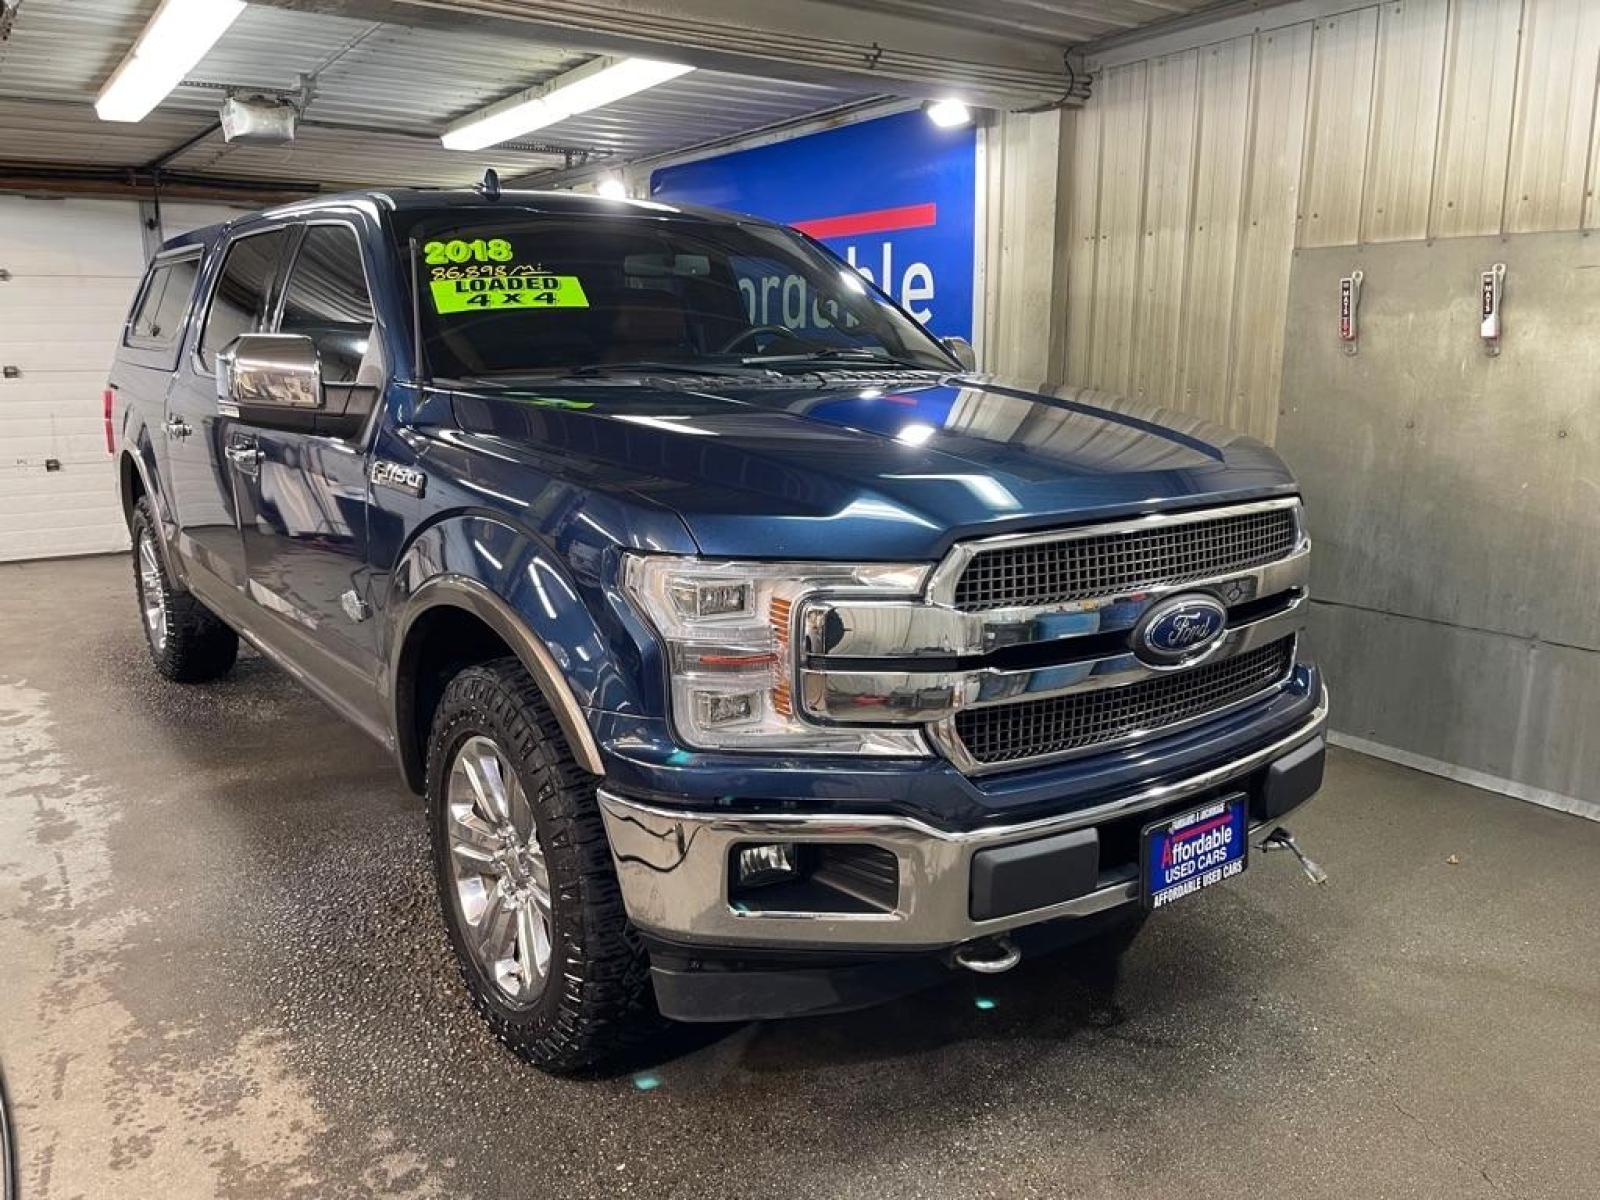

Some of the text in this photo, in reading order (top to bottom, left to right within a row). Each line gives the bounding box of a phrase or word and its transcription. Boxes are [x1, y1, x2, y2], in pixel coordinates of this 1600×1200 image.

[424, 239, 513, 264] 2018
[455, 277, 559, 293] LOADED
[1168, 611, 1210, 645] Ford
[1161, 824, 1232, 868] Affordable
[1165, 846, 1227, 884] USED CARS
[1152, 860, 1243, 908] AFFORDABLE USED CARS
